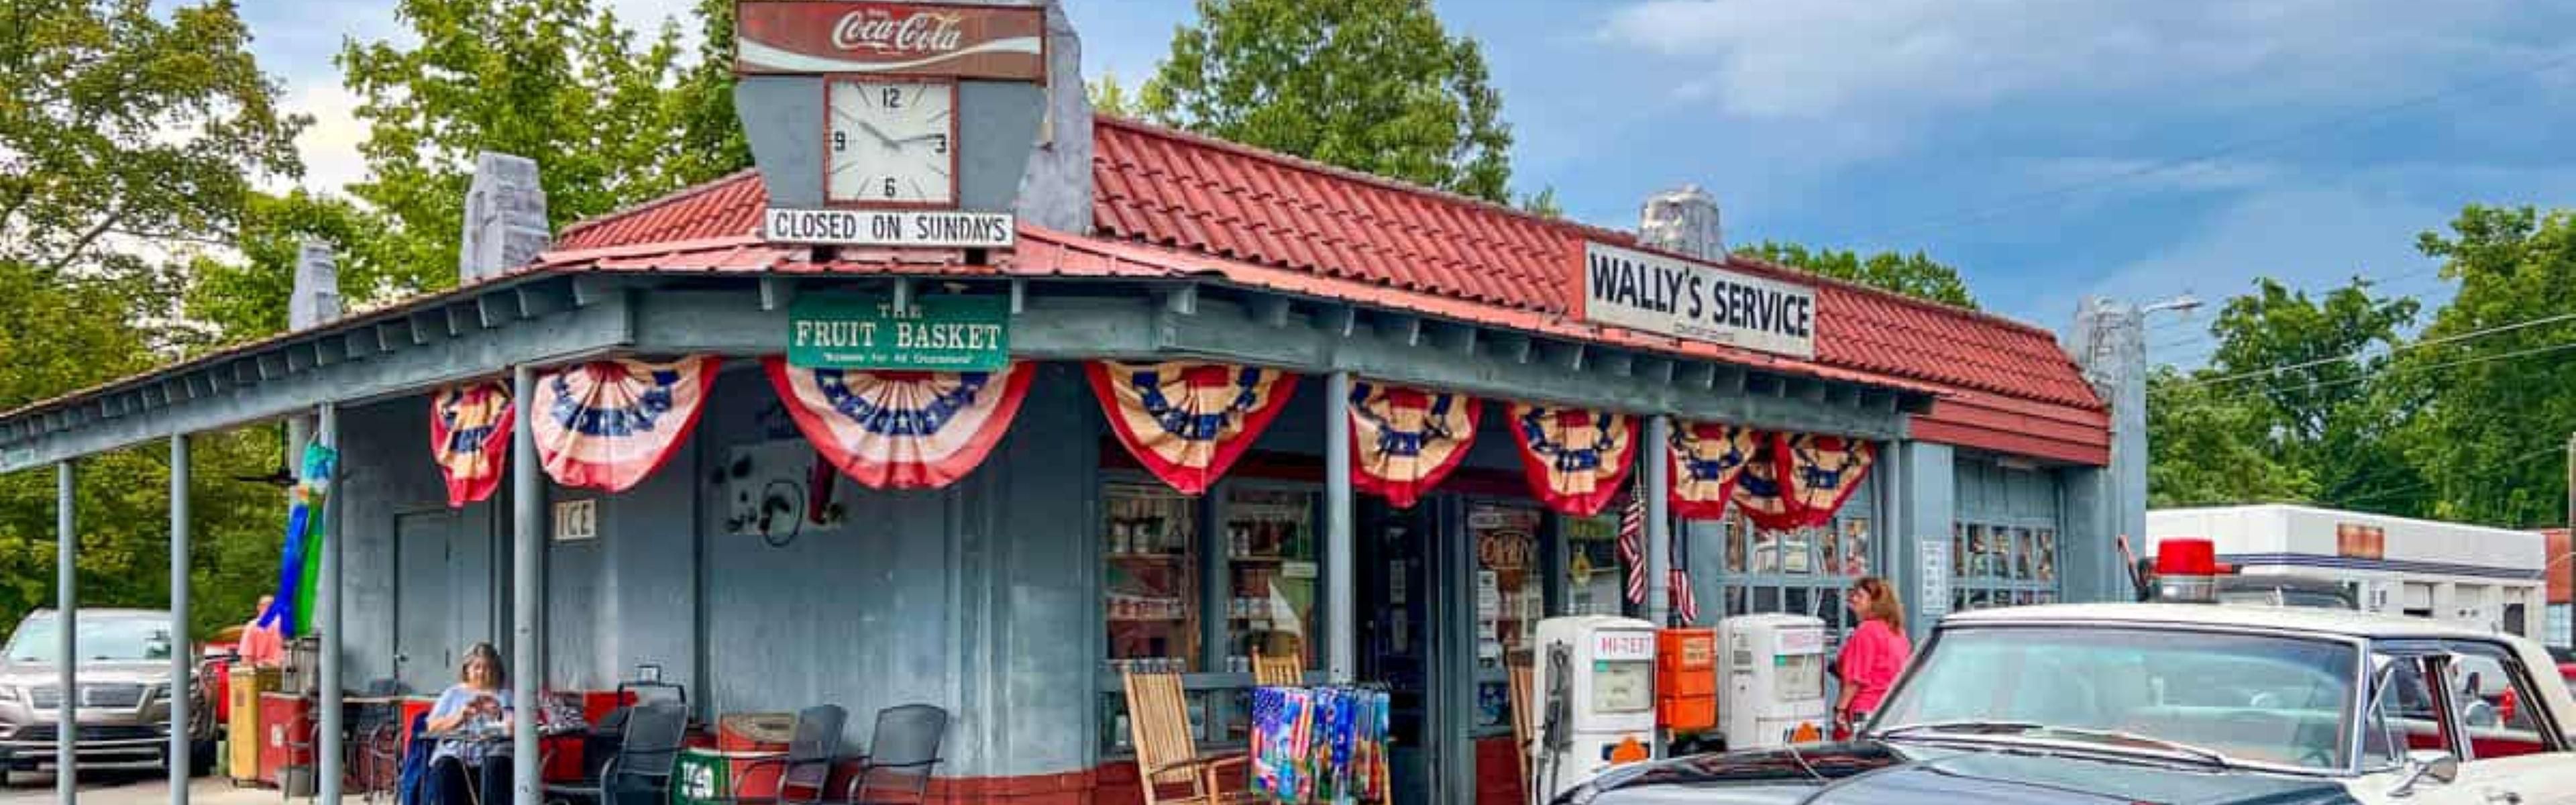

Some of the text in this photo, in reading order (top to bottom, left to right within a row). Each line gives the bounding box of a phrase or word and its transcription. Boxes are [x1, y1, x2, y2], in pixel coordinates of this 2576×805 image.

[831, 10, 961, 54] Coca-Cola
[882, 89, 901, 108] 12
[834, 131, 846, 152] 9
[934, 136, 947, 154] 3
[884, 178, 896, 197] 6
[775, 212, 1006, 241] CLOSED ON SUNDAYS
[1590, 252, 1810, 338] WALLY'S SERVICE
[796, 320, 1001, 350] FRUIT BASKET
[559, 502, 591, 536] ICE
